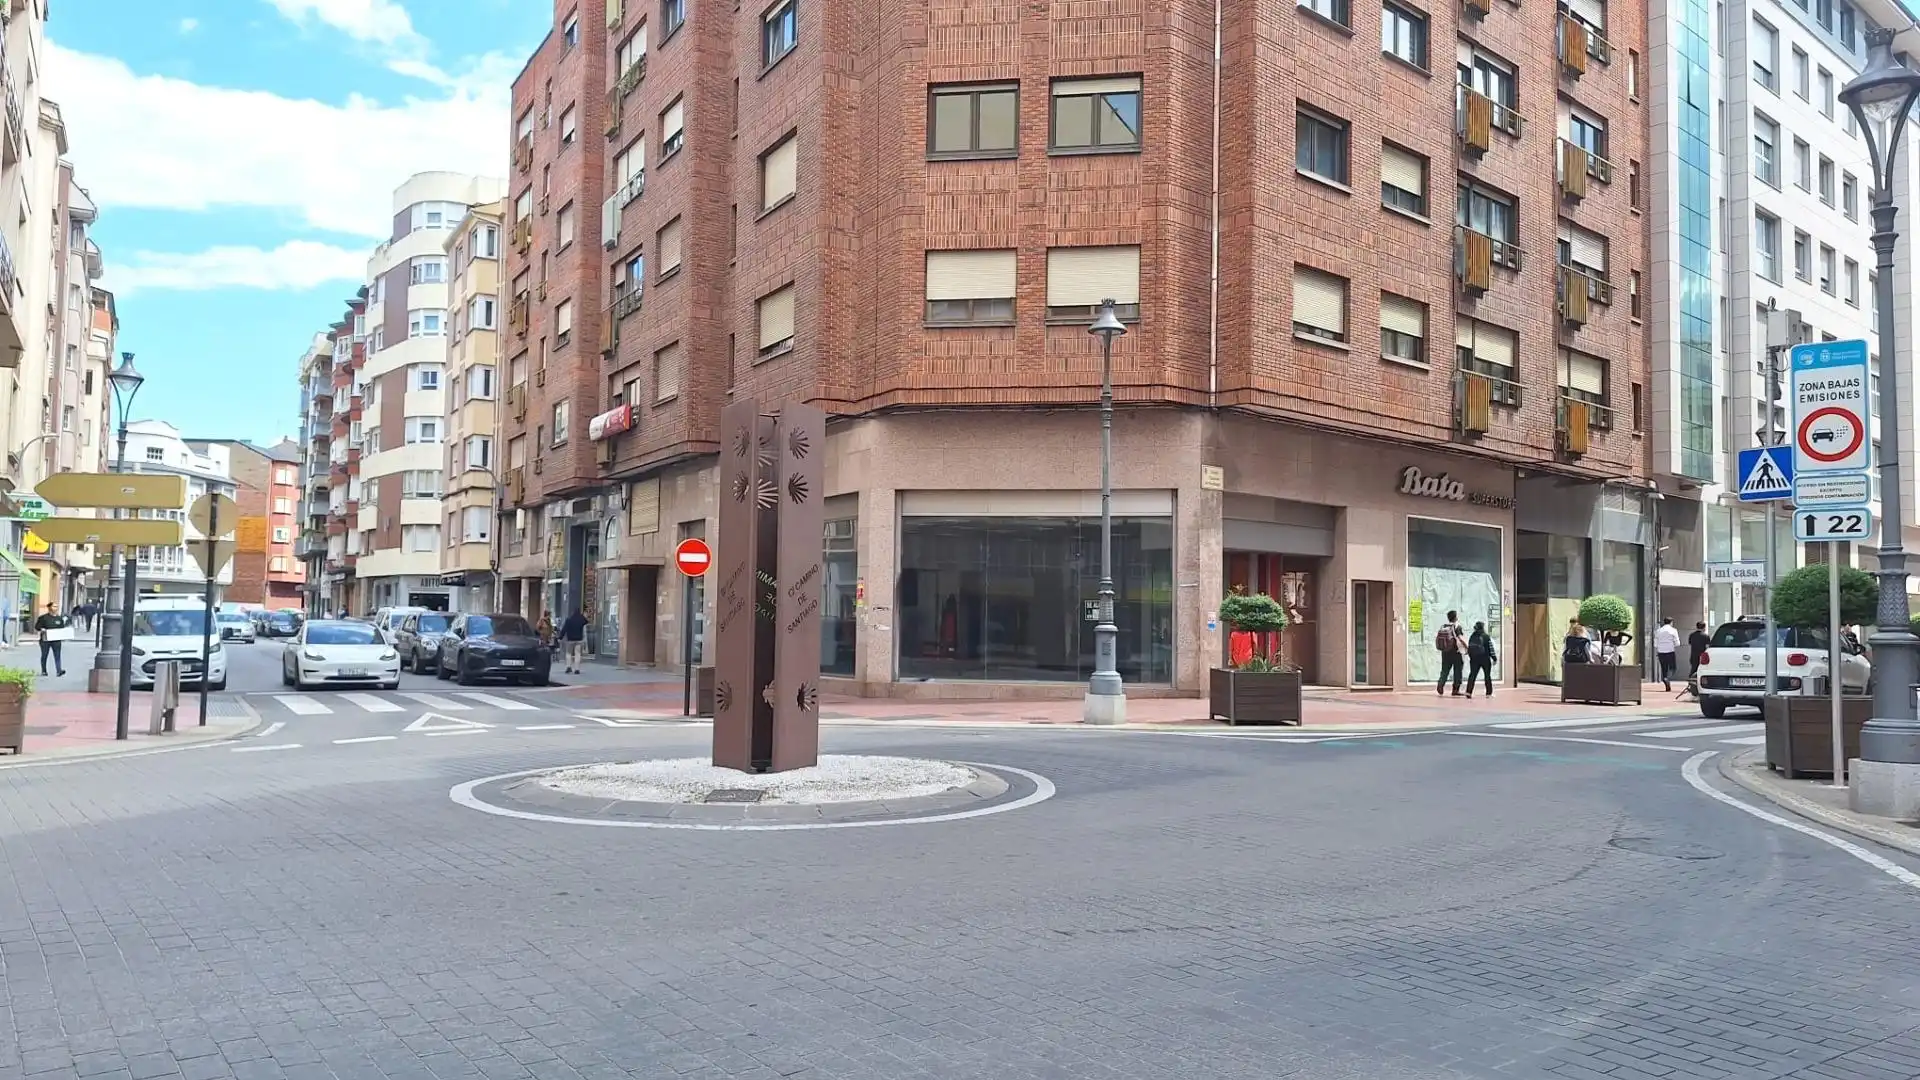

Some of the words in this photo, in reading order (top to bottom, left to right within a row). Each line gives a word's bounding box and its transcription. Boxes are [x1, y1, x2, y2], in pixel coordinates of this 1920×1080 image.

[1799, 382, 1826, 392] ZONA
[1828, 378, 1860, 389] BAJAS
[1799, 390, 1860, 403] EMISIONES
[1400, 466, 1465, 500] Bata
[1472, 492, 1518, 510] SUPERSTORE
[1828, 515, 1862, 533] 22
[795, 563, 819, 590] CAMINO
[1715, 568, 1731, 577] mi
[1733, 568, 1759, 577] casa
[797, 592, 808, 606] DE
[787, 599, 818, 634] SANTIAGO
